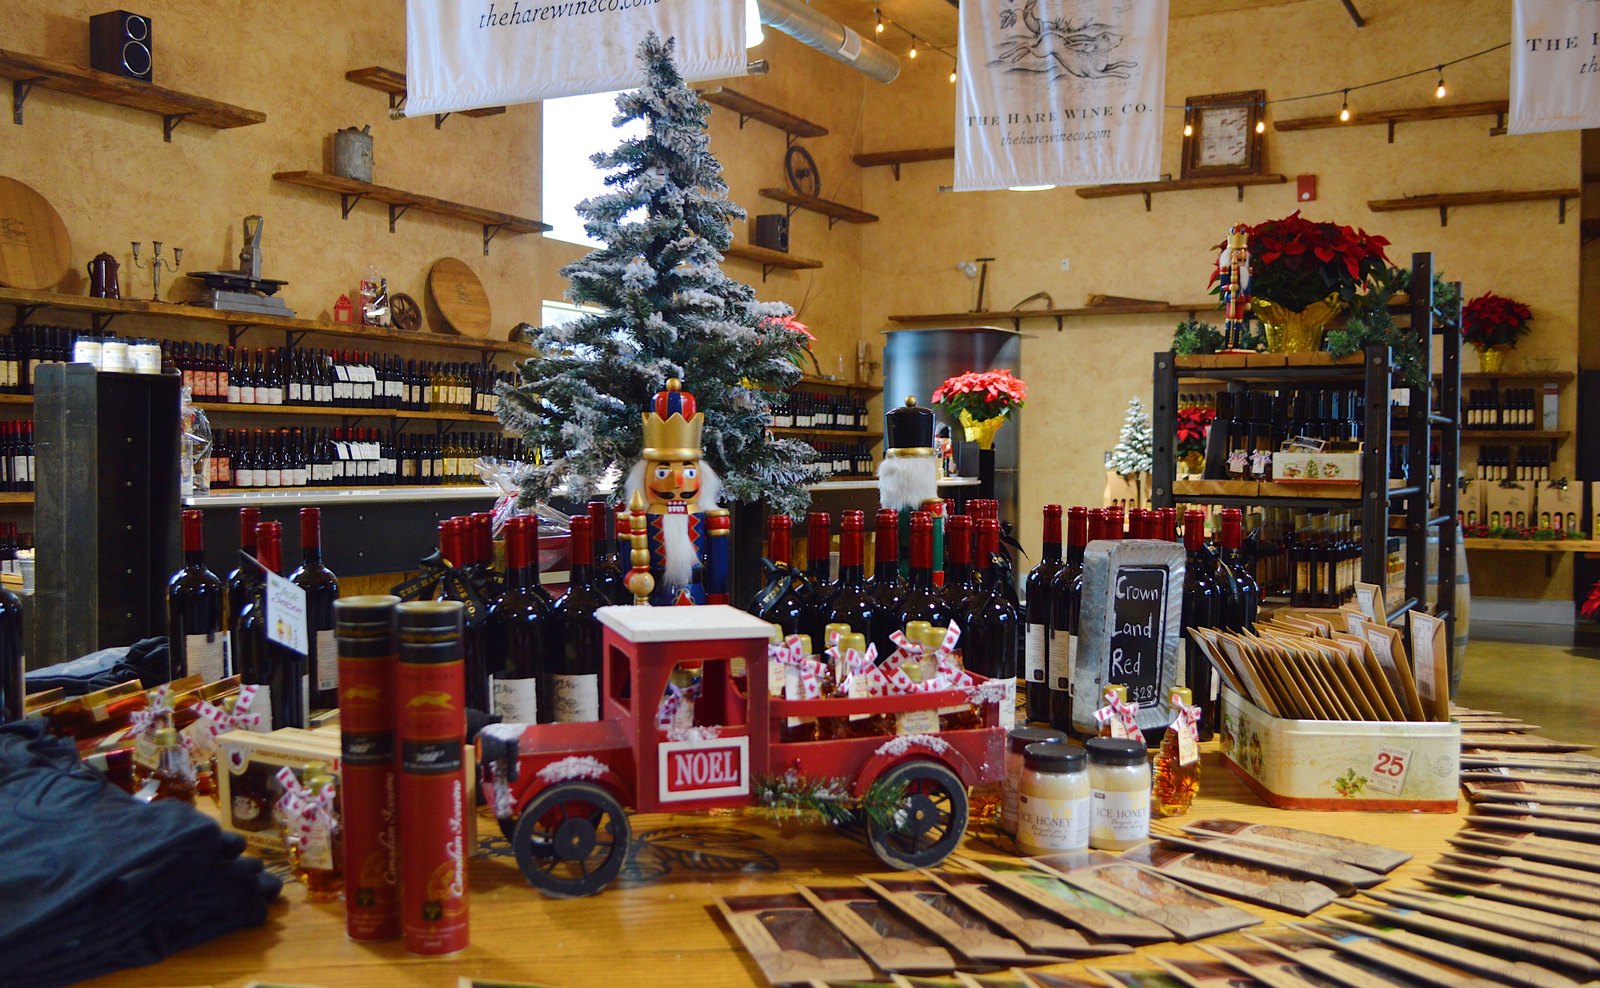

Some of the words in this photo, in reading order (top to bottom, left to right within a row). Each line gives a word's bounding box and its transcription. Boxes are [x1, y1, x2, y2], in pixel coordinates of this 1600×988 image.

[1525, 36, 1579, 51] THE
[1580, 55, 1600, 75] th
[966, 115, 1000, 127] THE
[1008, 111, 1057, 124] HARE
[1064, 105, 1113, 120] WINE
[1122, 103, 1153, 115] CO.
[1000, 128, 1111, 146] theharewineco.com
[1115, 575, 1159, 601] Crown
[1111, 612, 1152, 639] Land
[1112, 647, 1141, 677] Red
[1132, 684, 1153, 702] $28
[674, 751, 738, 786] NOEL
[1373, 752, 1404, 777] 25
[1036, 815, 1072, 828] HONEY
[1095, 807, 1113, 818] ICE
[1116, 808, 1147, 819] HONEY
